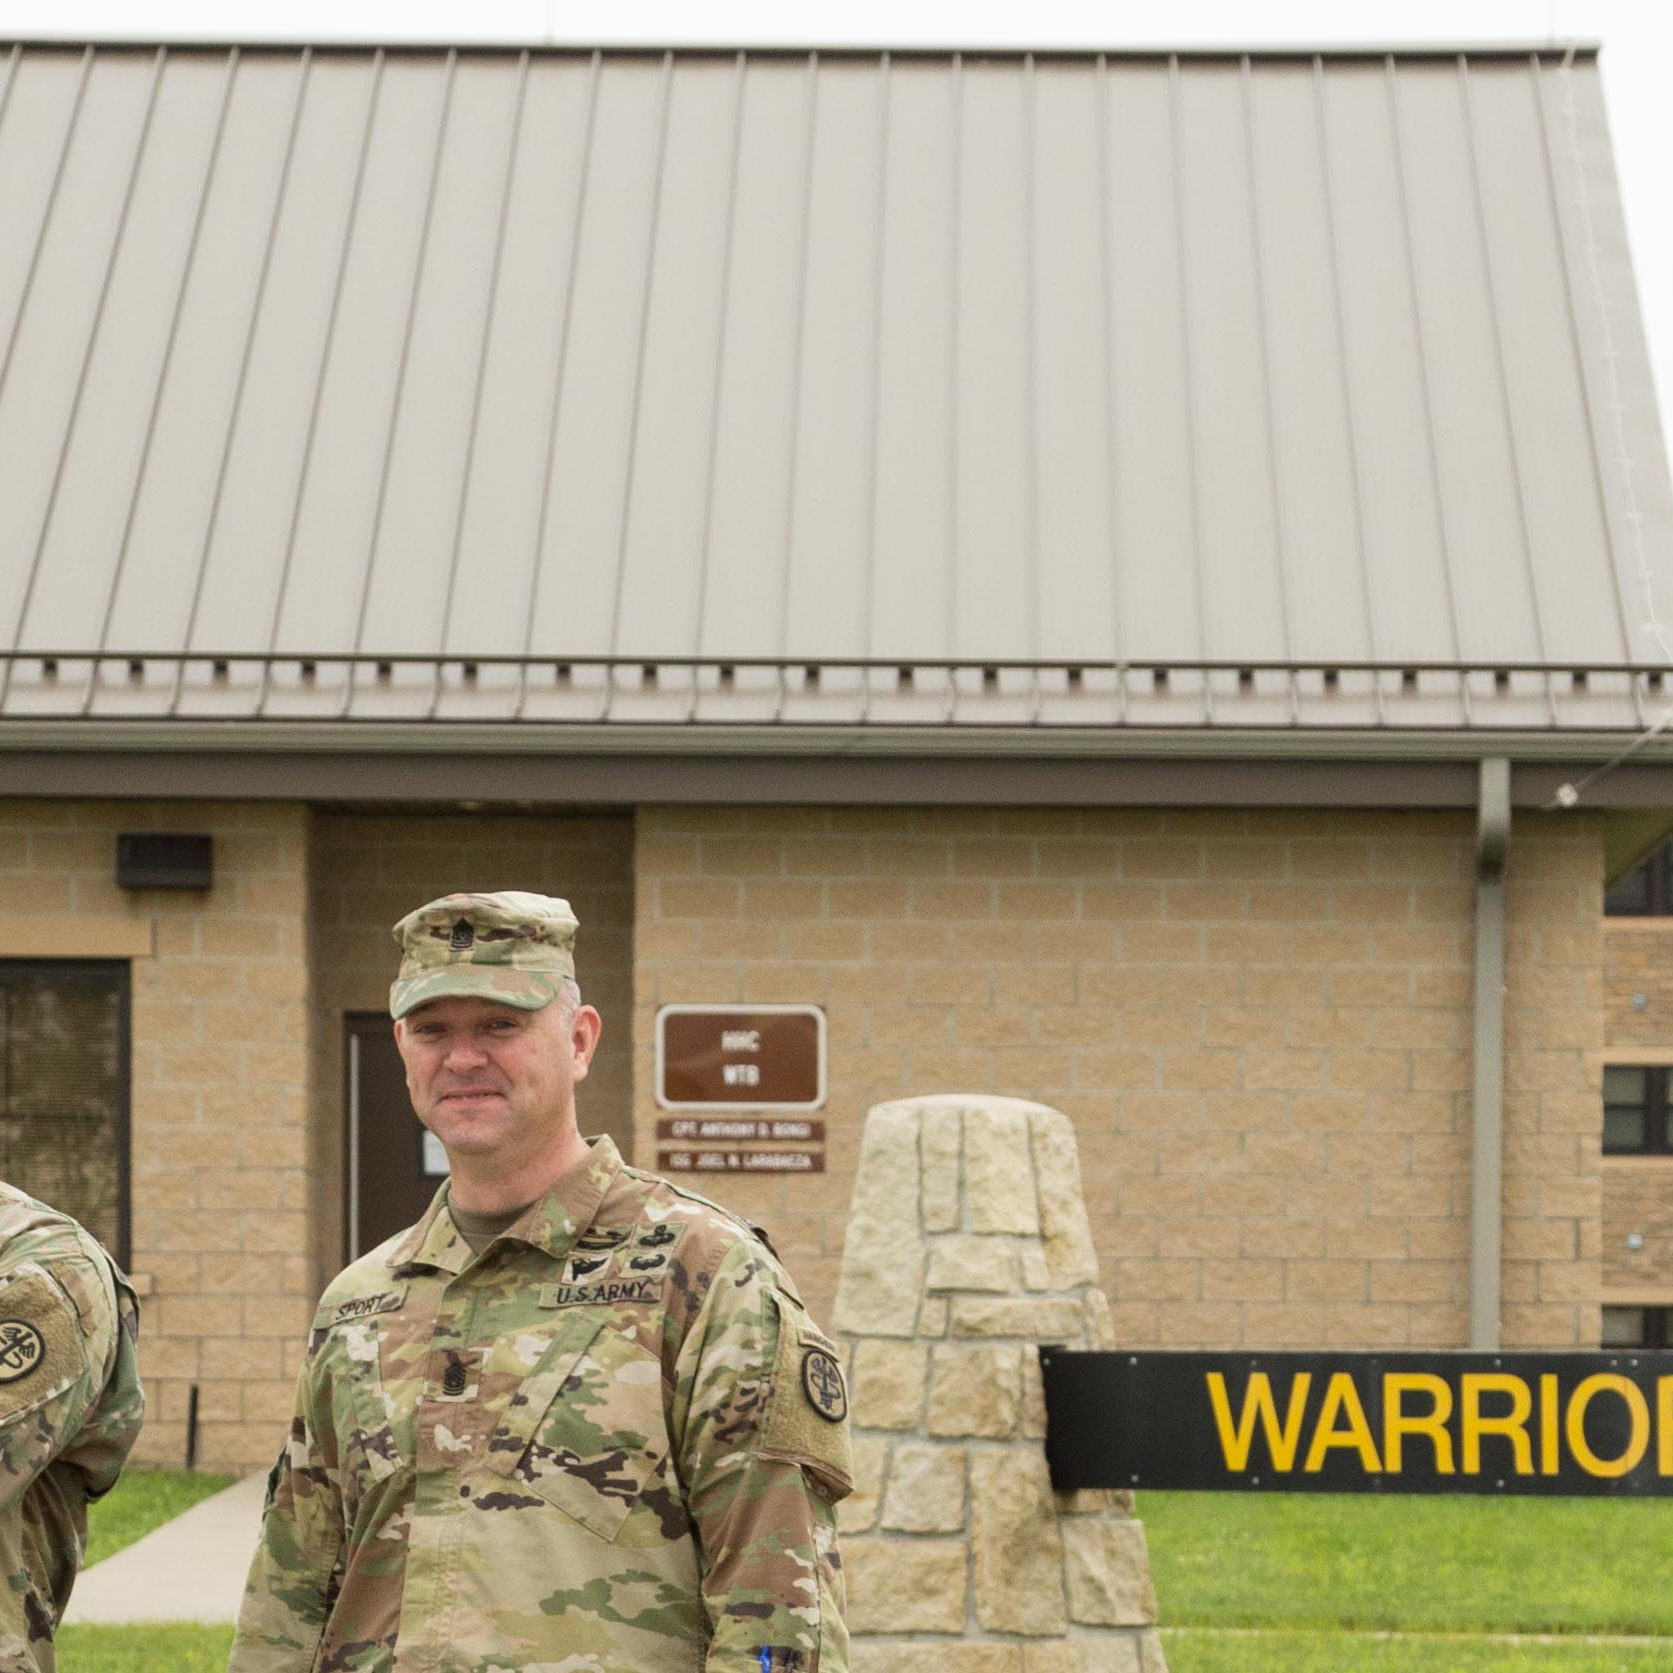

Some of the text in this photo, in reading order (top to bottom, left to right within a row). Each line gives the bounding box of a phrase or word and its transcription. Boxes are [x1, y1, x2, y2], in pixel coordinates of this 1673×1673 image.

[723, 1065, 760, 1086] WTB
[696, 1152, 726, 1169] JOEL
[593, 1280, 651, 1301] ARMY
[335, 1291, 394, 1320] SPORT
